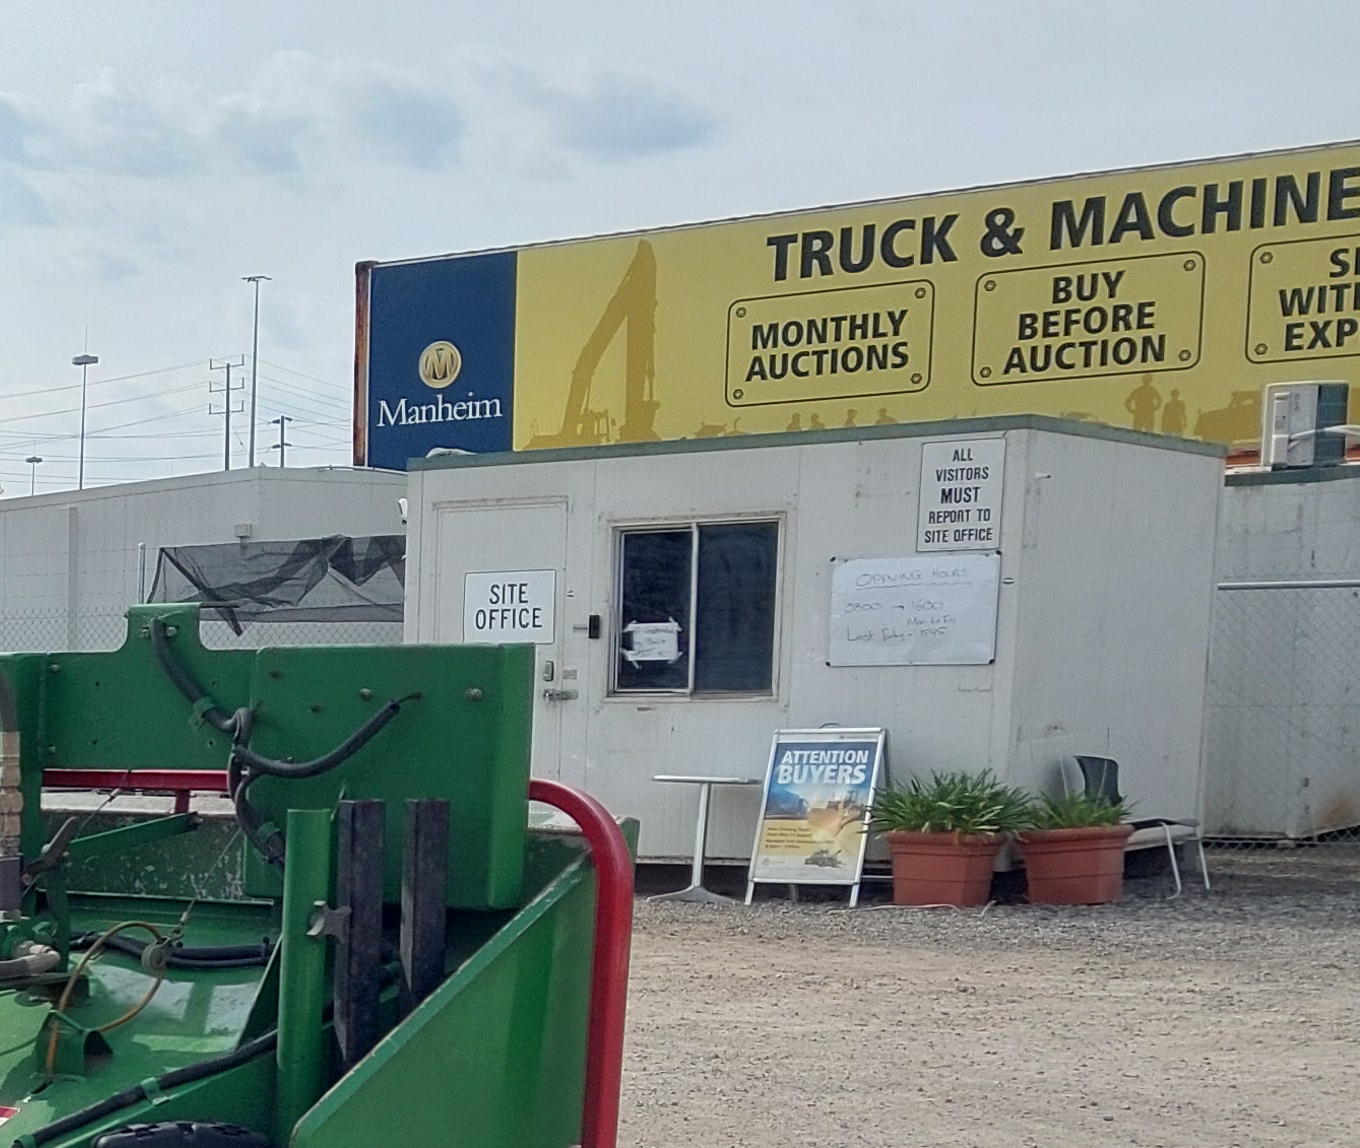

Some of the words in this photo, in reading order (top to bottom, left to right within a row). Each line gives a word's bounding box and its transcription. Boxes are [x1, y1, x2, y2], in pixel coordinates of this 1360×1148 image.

[766, 213, 960, 282] TRUCK
[980, 207, 1026, 258] &
[1052, 269, 1126, 304] BUY
[1278, 282, 1360, 318] WIT
[751, 309, 909, 350] MONTHLY
[1018, 301, 1156, 341] BEFORE
[745, 341, 910, 382] AUCTIONS
[1002, 334, 1166, 375] AUCTION
[376, 391, 503, 427] Manheim
[952, 448, 974, 462] ALL
[935, 466, 989, 482] VISITORS
[940, 486, 981, 504] MUST
[928, 509, 970, 524] REPORT
[977, 508, 991, 522] TO
[924, 530, 949, 544] SITE
[954, 528, 993, 542] OFFICE
[489, 582, 529, 605] SITE
[475, 607, 543, 630] OFFICE
[781, 750, 869, 765] ATTENTION
[777, 764, 867, 785] BUYERS
